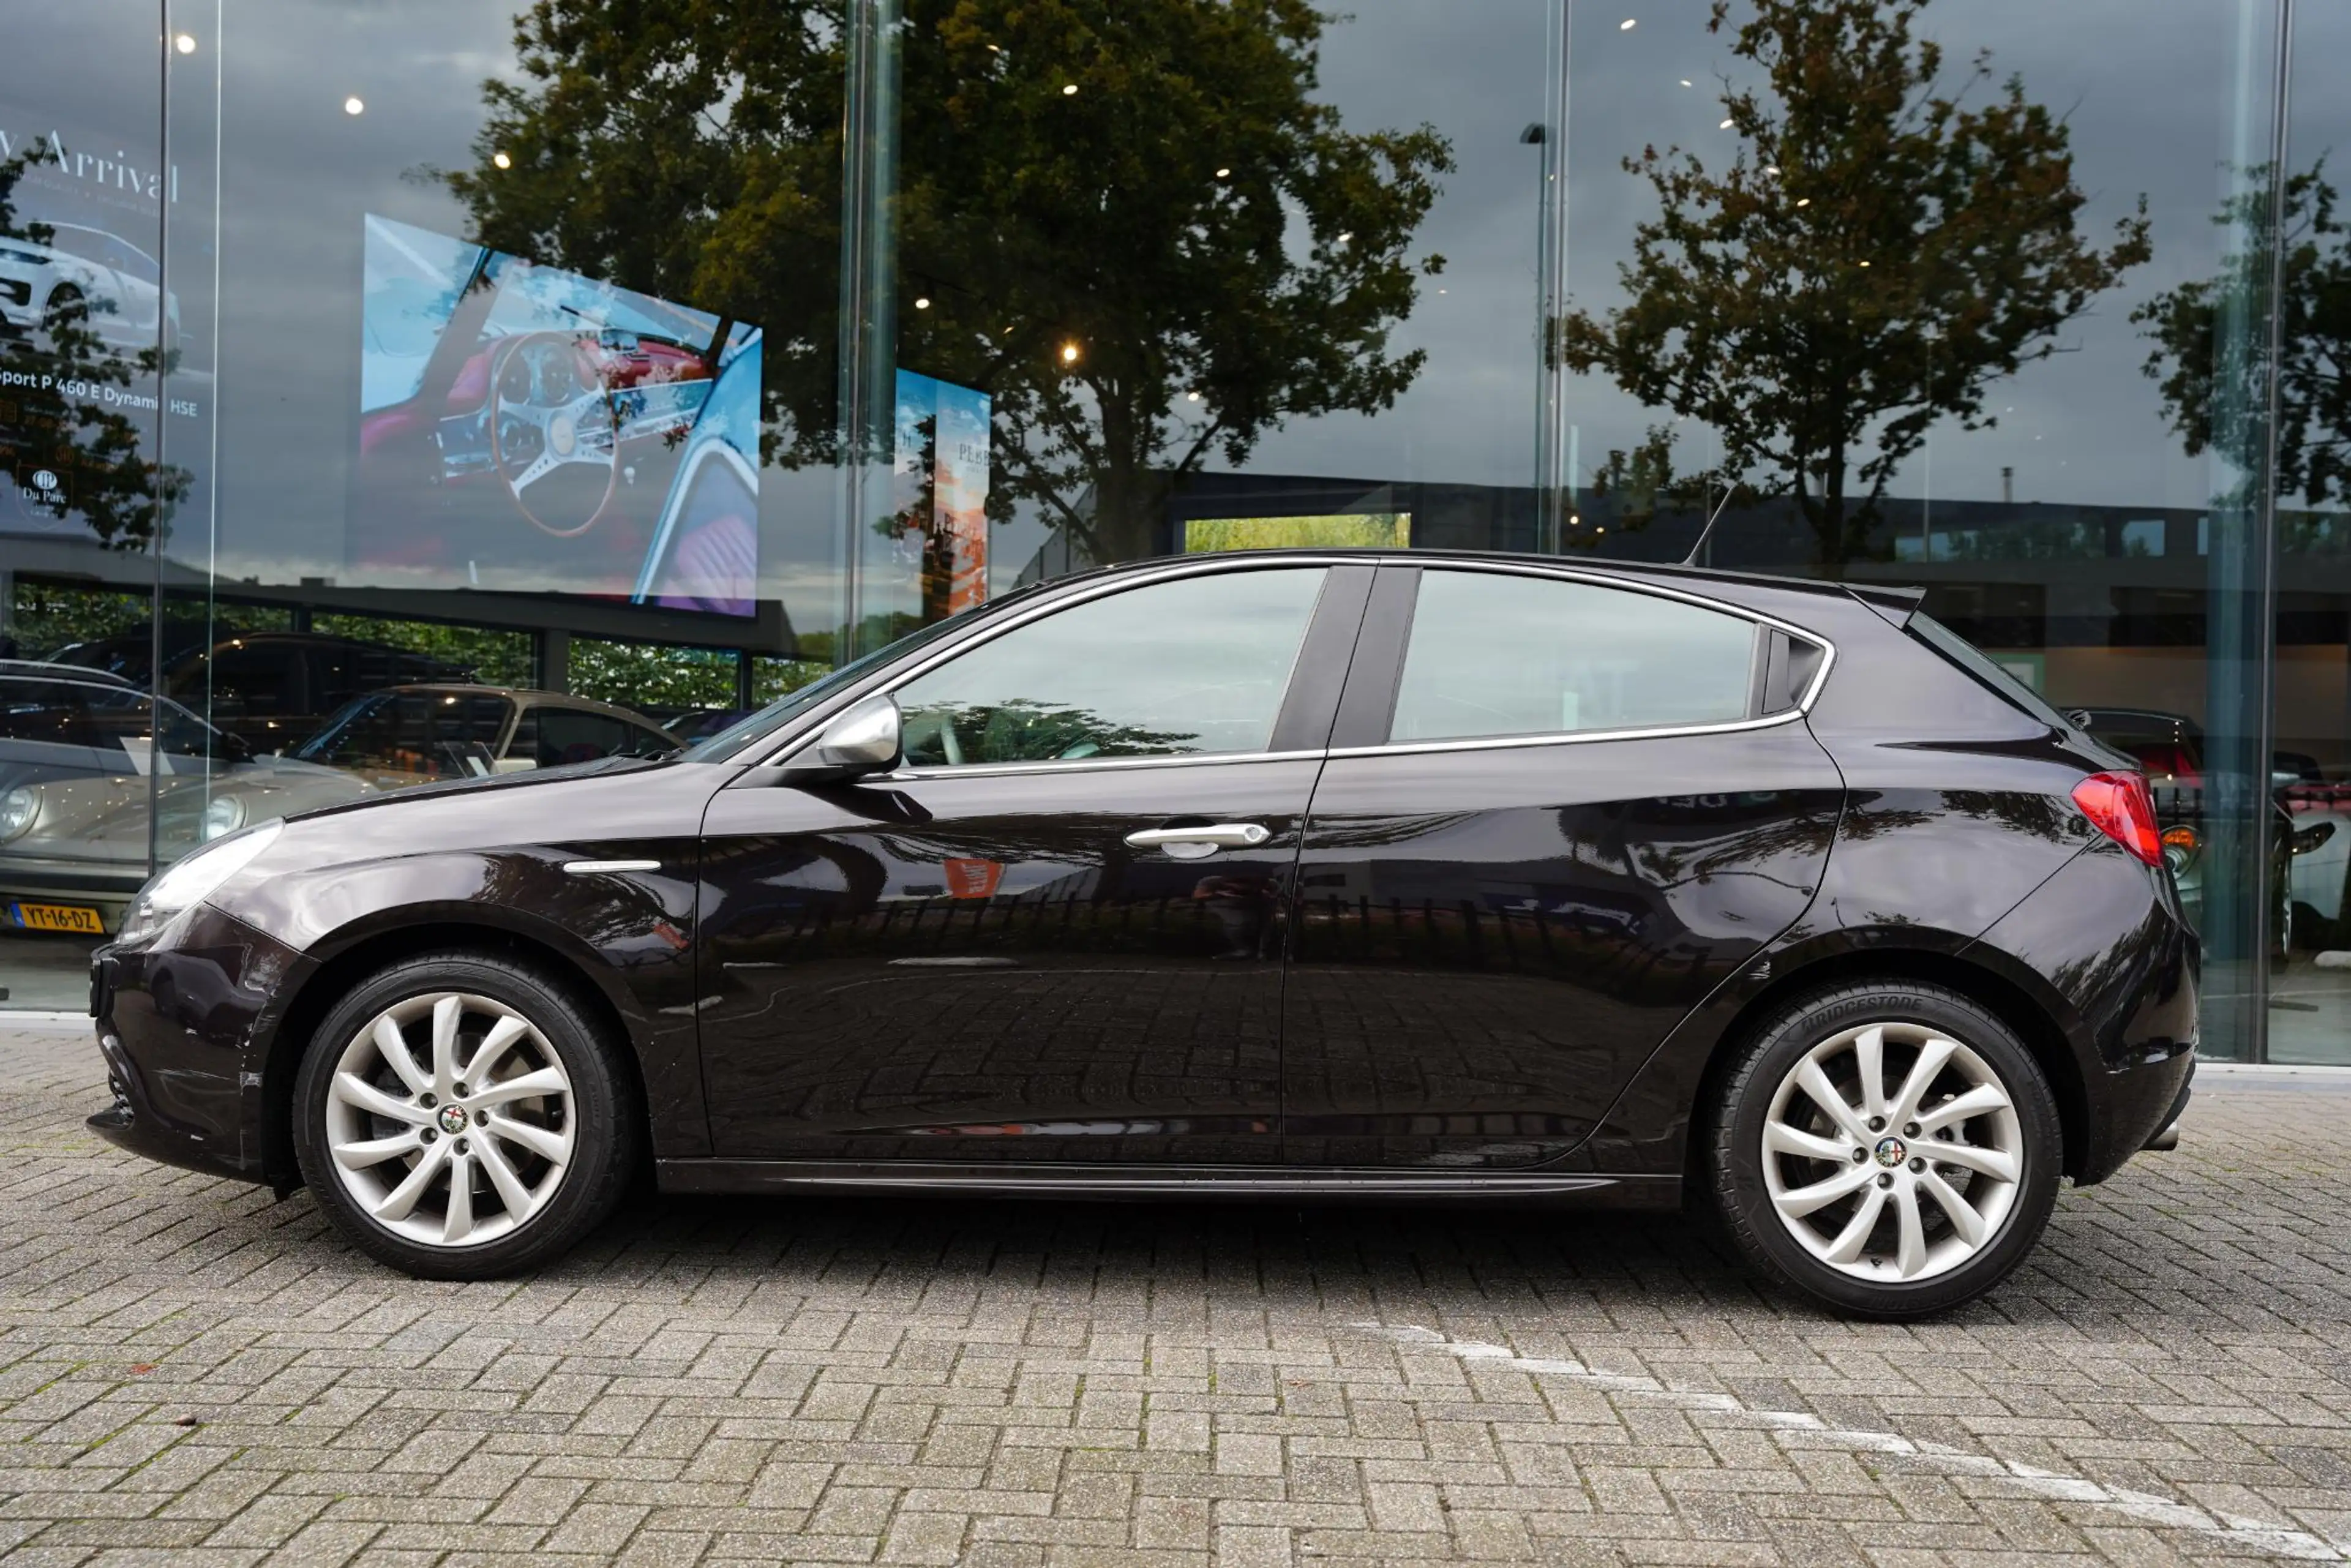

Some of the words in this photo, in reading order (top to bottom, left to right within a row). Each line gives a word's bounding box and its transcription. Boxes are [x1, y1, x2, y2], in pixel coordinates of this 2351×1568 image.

[40, 129, 178, 203] Arrival
[41, 374, 52, 390] P
[56, 378, 85, 397] 460
[91, 384, 100, 400] E
[104, 386, 159, 410] Dynami
[170, 399, 197, 417] HSE
[23, 487, 40, 501] Du
[26, 907, 96, 929] YT-16-DZ
[1801, 996, 1923, 1033] BRIDGESTONE
